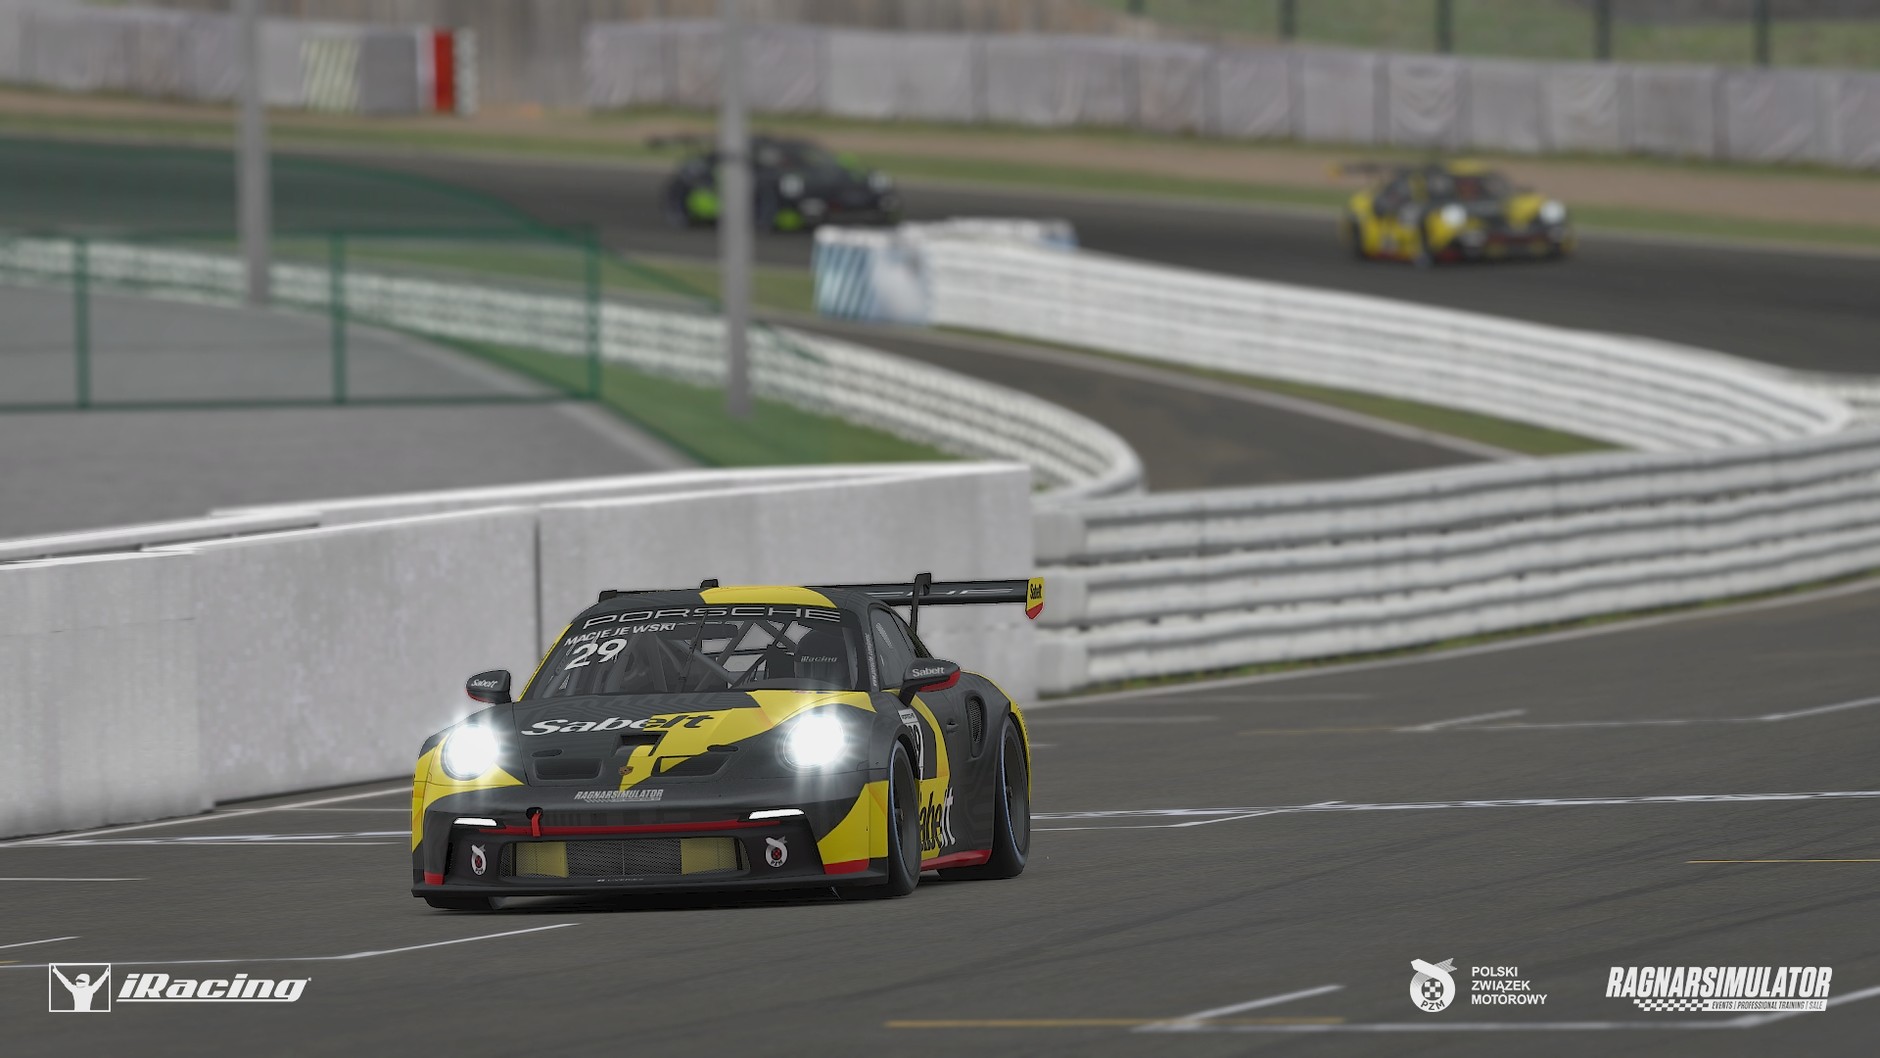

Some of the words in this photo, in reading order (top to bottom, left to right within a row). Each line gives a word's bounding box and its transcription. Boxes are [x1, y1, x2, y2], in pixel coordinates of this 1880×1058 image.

[583, 607, 841, 629] PORSCHE
[564, 638, 628, 671] 29
[911, 666, 945, 677] Sabelt
[471, 678, 498, 689] Sabelt
[521, 714, 715, 736] Sabelt
[574, 789, 664, 800] RAGNARSIMULATOR
[920, 786, 956, 851] abelt
